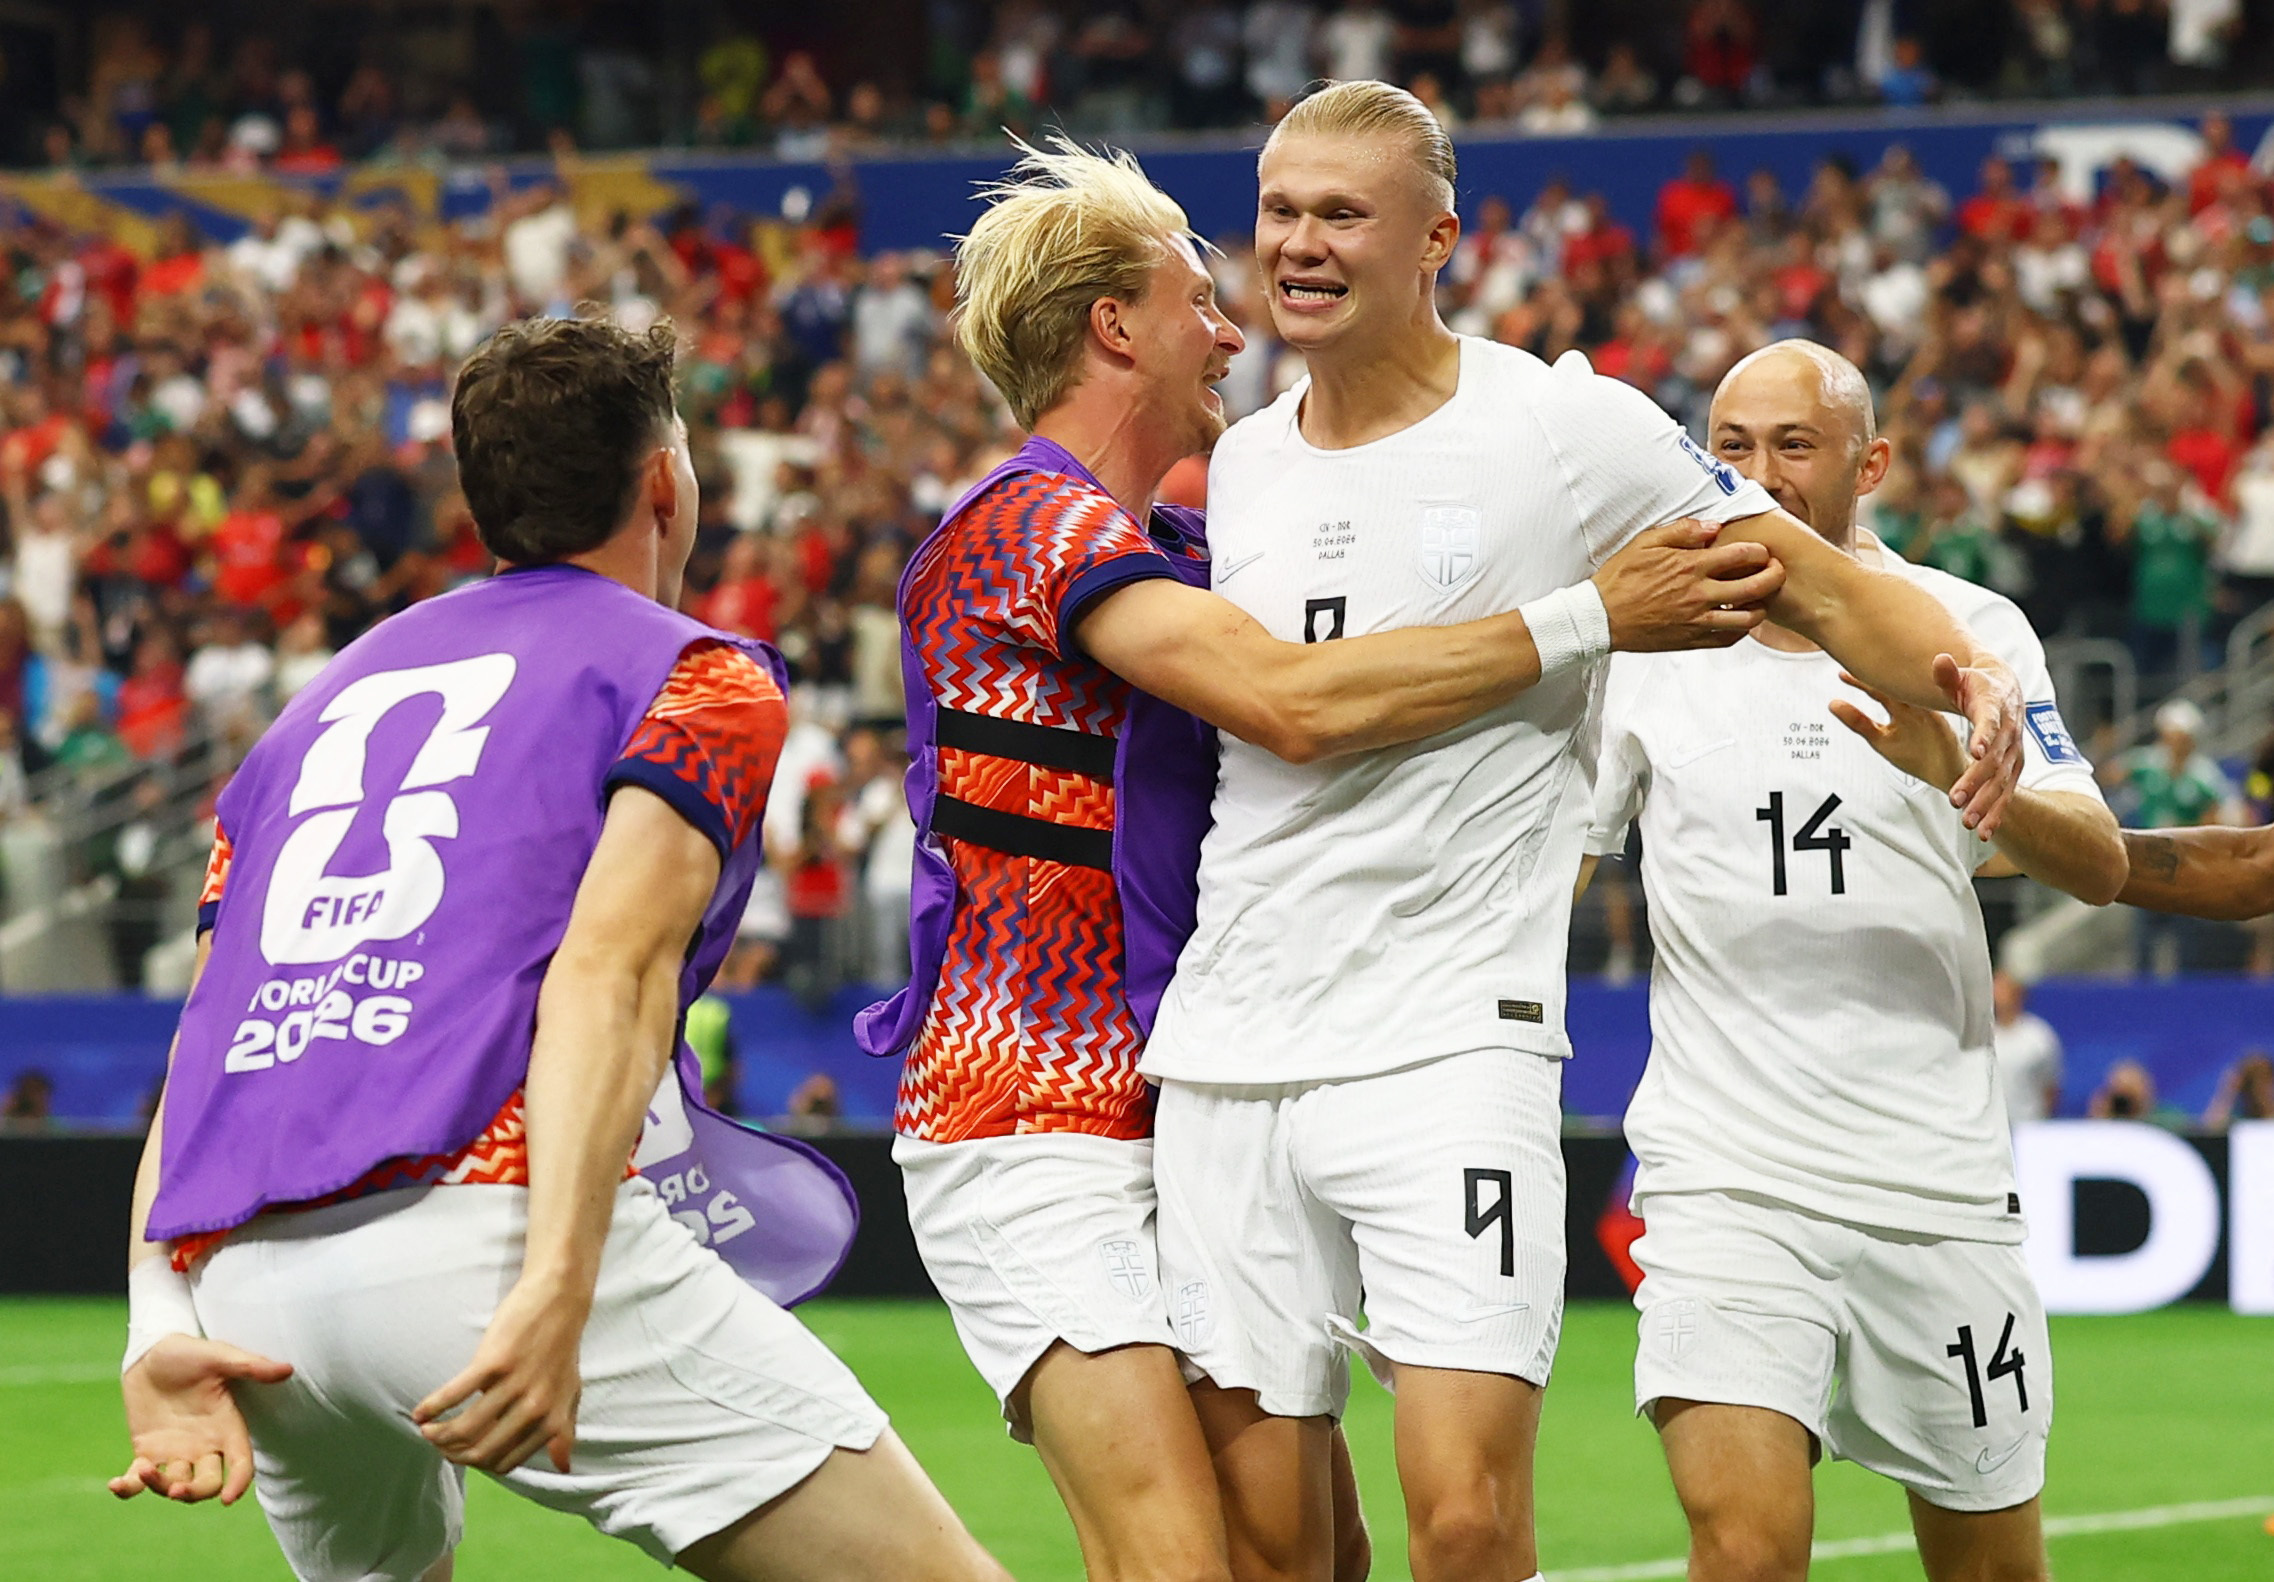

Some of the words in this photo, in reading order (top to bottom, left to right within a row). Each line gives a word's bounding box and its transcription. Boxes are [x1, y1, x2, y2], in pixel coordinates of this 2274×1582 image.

[1318, 549, 1345, 560] DALLAS
[1791, 750, 1820, 760] DALLAS
[1756, 790, 1851, 896] 14
[301, 889, 385, 930] FIFA
[343, 953, 425, 990] CUP
[224, 990, 414, 1074] 2026
[1463, 1167, 1515, 1278] 9
[1945, 1311, 2030, 1429] 14
